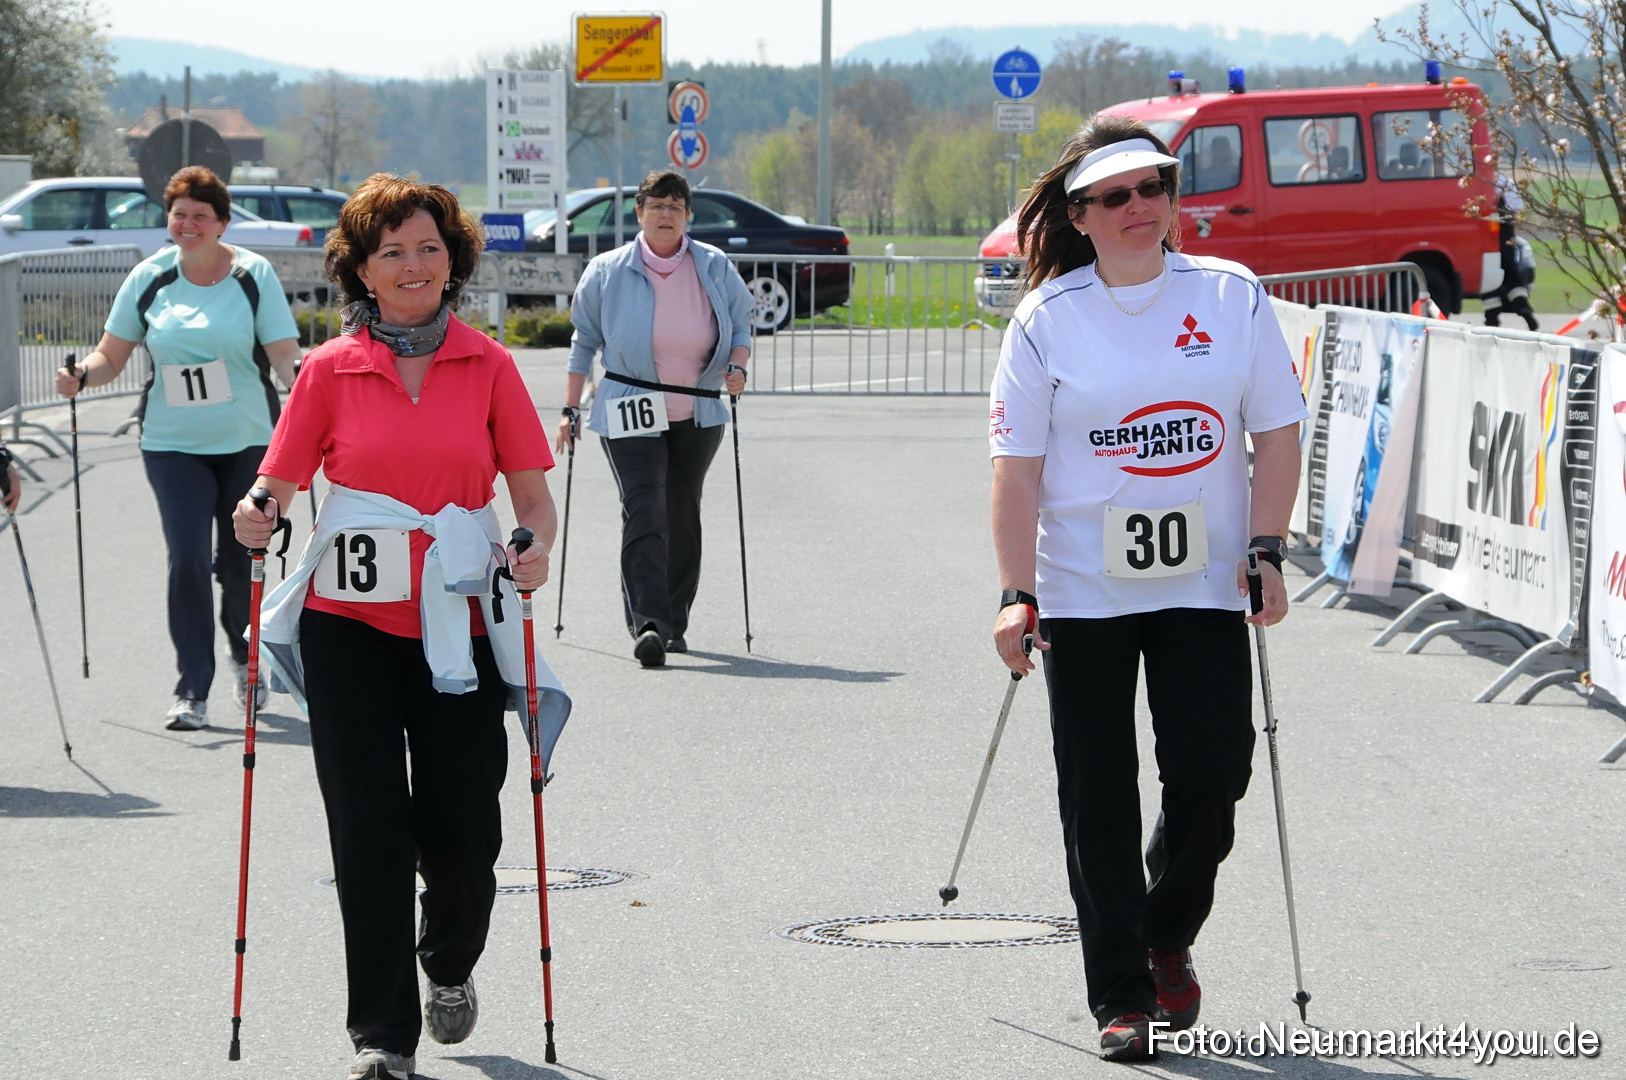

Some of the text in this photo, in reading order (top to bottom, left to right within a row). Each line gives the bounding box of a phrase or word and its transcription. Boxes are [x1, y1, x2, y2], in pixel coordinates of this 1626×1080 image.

[1180, 343, 1211, 352] MITSUBISHI
[1184, 350, 1210, 359] MOTORS
[180, 367, 208, 401] 11
[617, 397, 655, 432] 116
[1568, 409, 1590, 422] Erdgas
[1088, 416, 1198, 447] GERHART
[1094, 433, 1214, 460] AUTOHAUS JÄNIG
[1125, 511, 1189, 571] 30
[333, 532, 378, 593] 13
